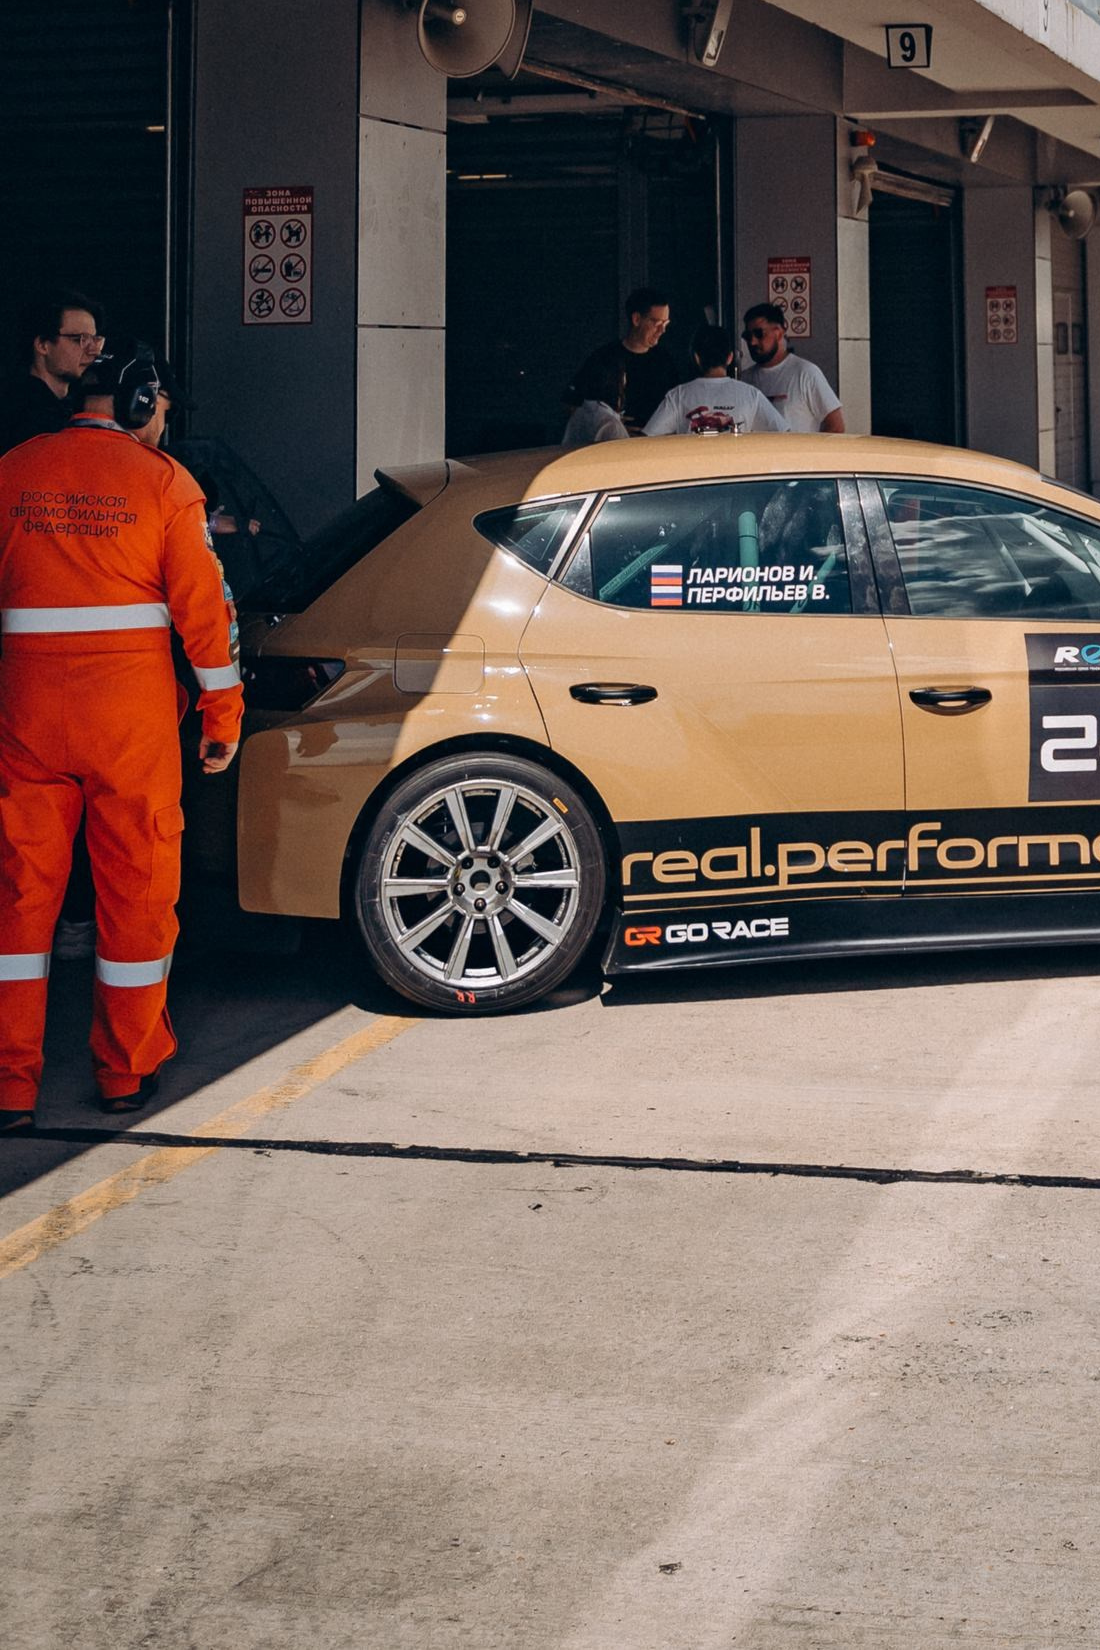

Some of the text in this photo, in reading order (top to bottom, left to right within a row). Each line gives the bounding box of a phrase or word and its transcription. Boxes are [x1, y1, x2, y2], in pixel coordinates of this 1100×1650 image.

[900, 31, 916, 63] 9
[245, 197, 312, 206] ПОВЫШЕННОЙ
[251, 204, 308, 213] ОПАСНОСТИ
[21, 491, 127, 508] российская
[9, 505, 137, 525] автомобильная
[23, 518, 119, 538] федерация
[687, 565, 818, 584] ЛАРИОНОВ И.
[687, 584, 830, 604] ПЕРФИЛЬЕВ В.
[624, 917, 789, 947] GR GO RACE
